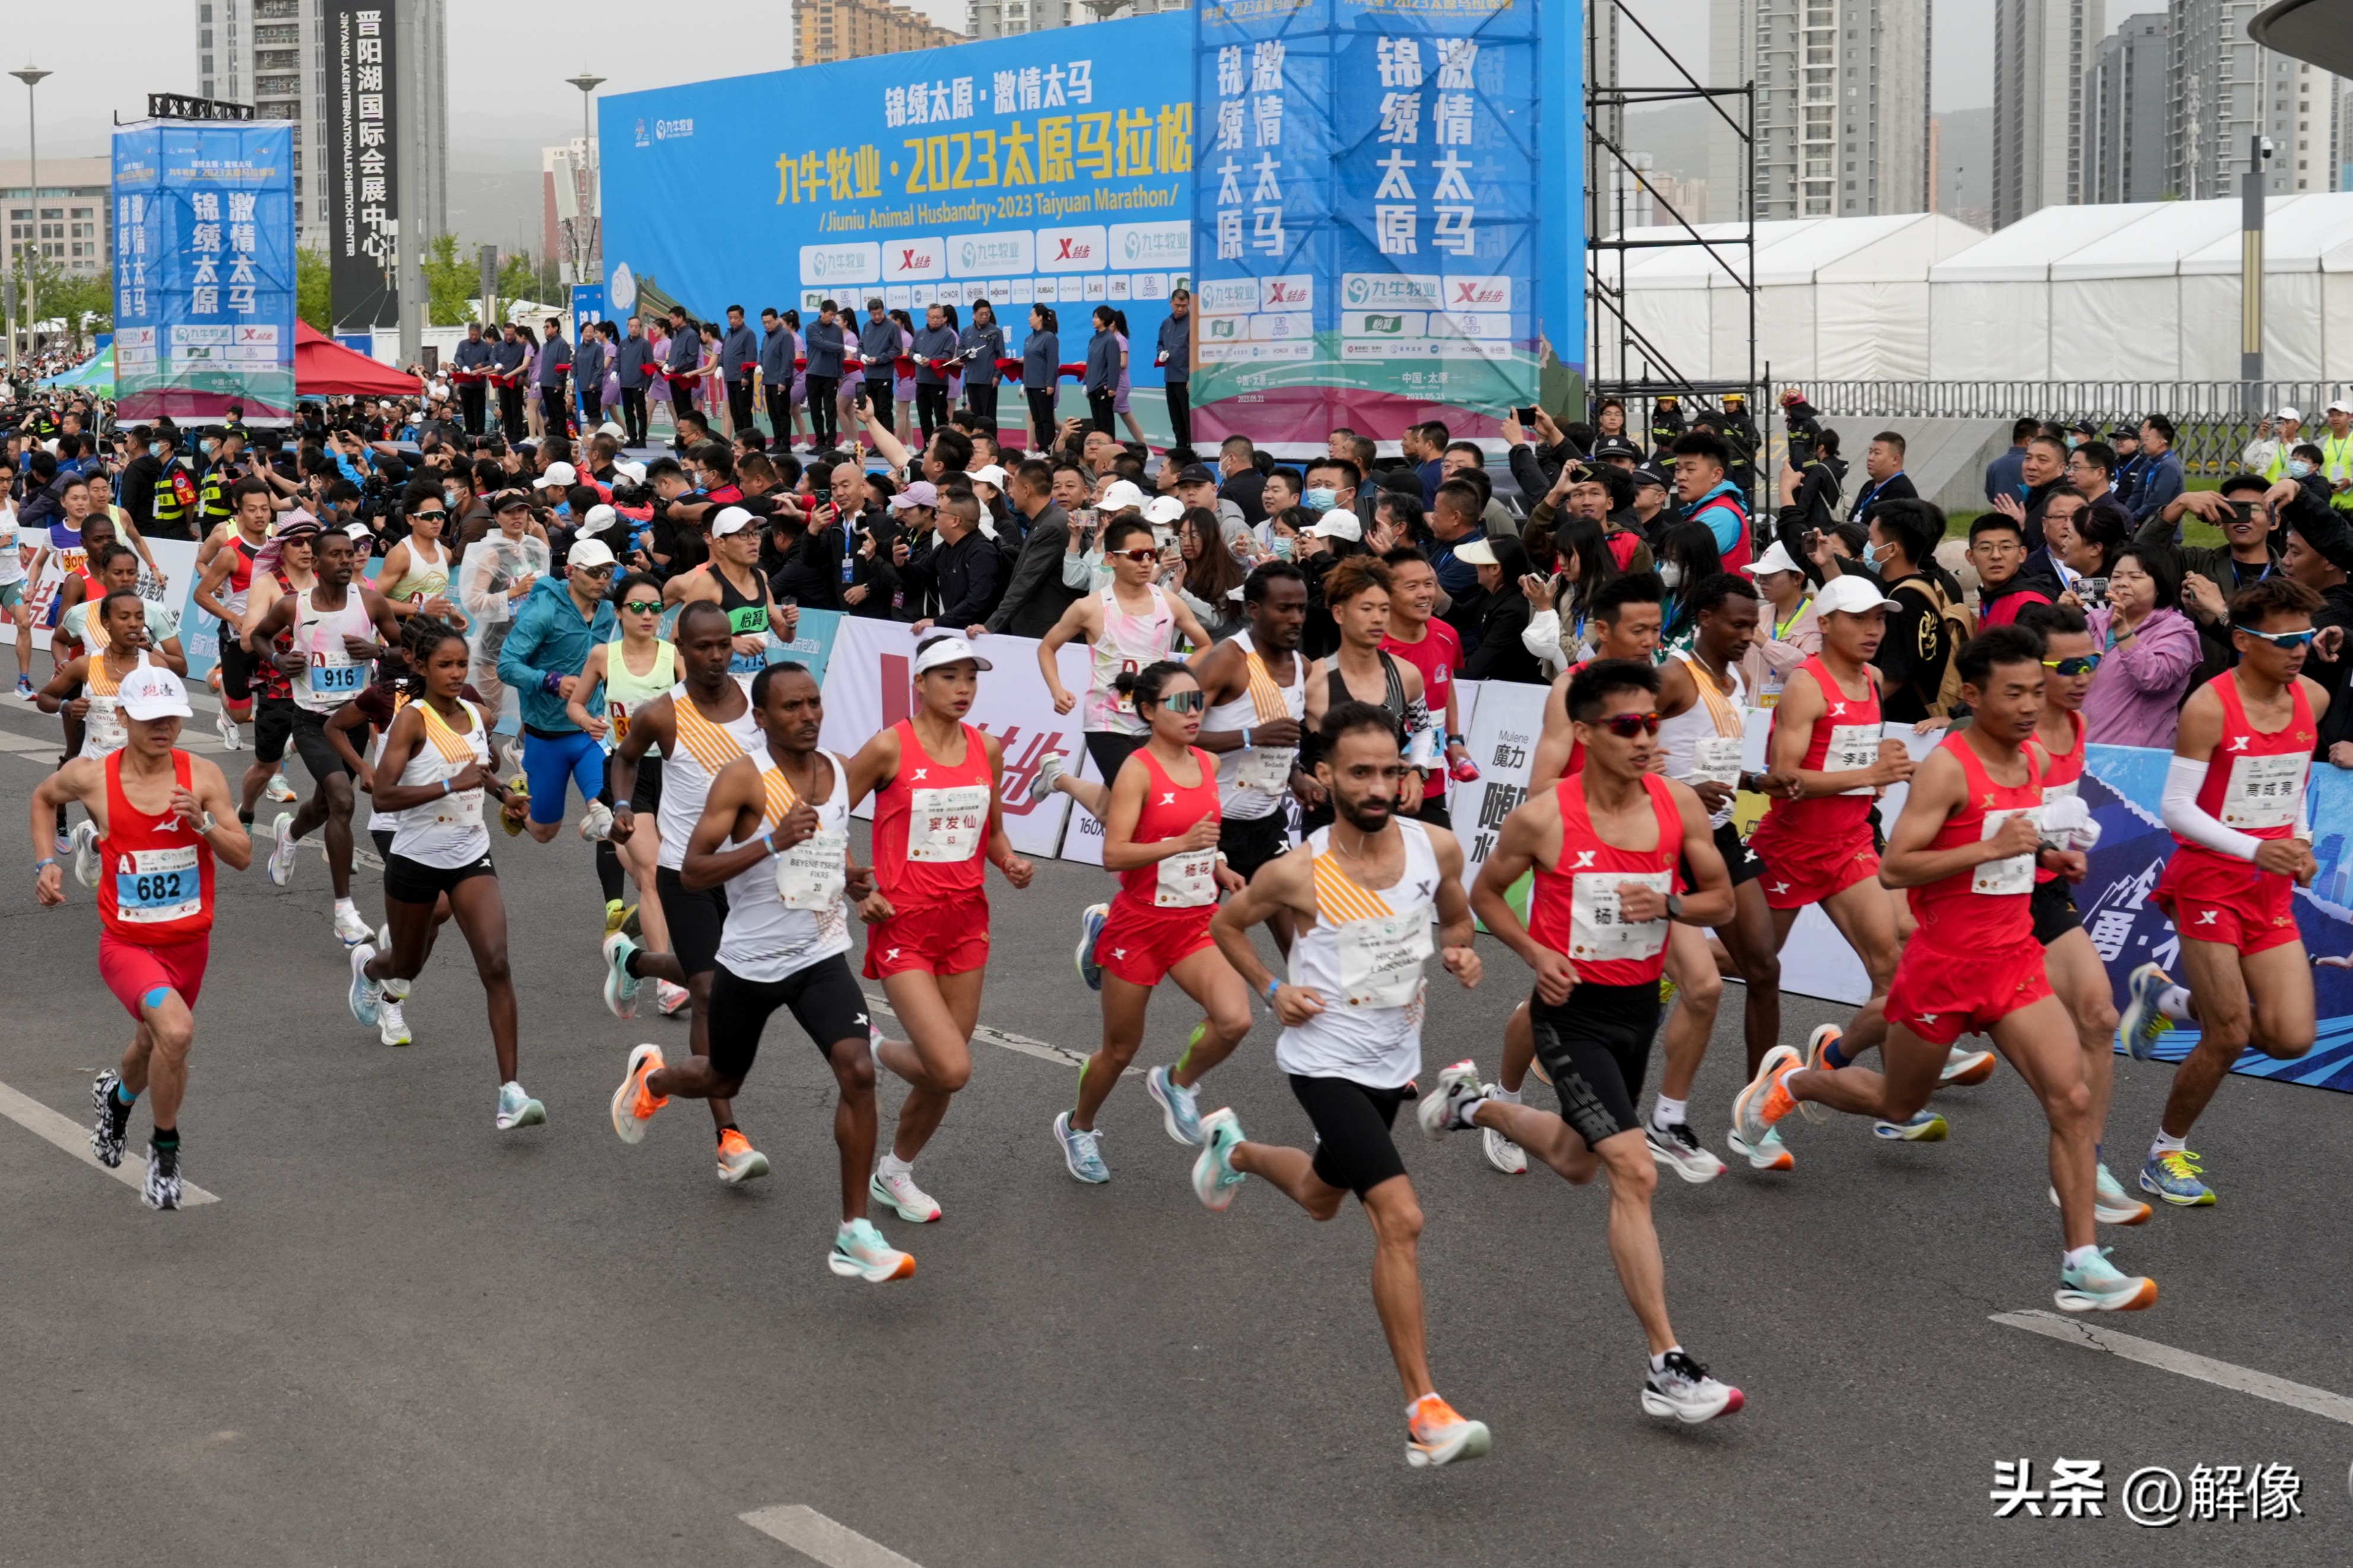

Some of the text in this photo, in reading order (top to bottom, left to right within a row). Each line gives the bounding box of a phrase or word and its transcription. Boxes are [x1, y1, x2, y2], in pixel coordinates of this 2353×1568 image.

[885, 59, 1093, 128] 锦绣太原·激情太马
[356, 10, 387, 257] 晋阳湖国际会展中心
[1217, 44, 1245, 261] 锦绣太原
[1252, 40, 1286, 257] 激情太马
[1374, 36, 1422, 255] 锦绣太原
[1432, 37, 1479, 256] 激情太马
[869, 204, 914, 229] Animal
[1035, 190, 1091, 220] Taiyuan
[1142, 231, 1188, 250] 九牛牧业
[192, 192, 221, 314] 锦绣太原
[228, 193, 256, 314] 激情太马
[978, 241, 1019, 260] 九牛牧业
[827, 252, 865, 269] 九牛牧业
[1372, 281, 1437, 297] 九牛牧业
[1402, 373, 1449, 384] 中国·太原
[740, 610, 763, 628] 怡寶
[312, 653, 322, 667] A
[325, 669, 354, 687] 916
[142, 682, 174, 697] 跑渣
[1498, 730, 1529, 745] Mulene
[1492, 744, 1526, 769] 魔力
[459, 793, 481, 802] SOBOKA
[928, 815, 977, 832] 窦发仙
[119, 854, 132, 874] A
[790, 858, 818, 869] BEYENE
[137, 873, 180, 901] 682
[813, 883, 822, 892] 20
